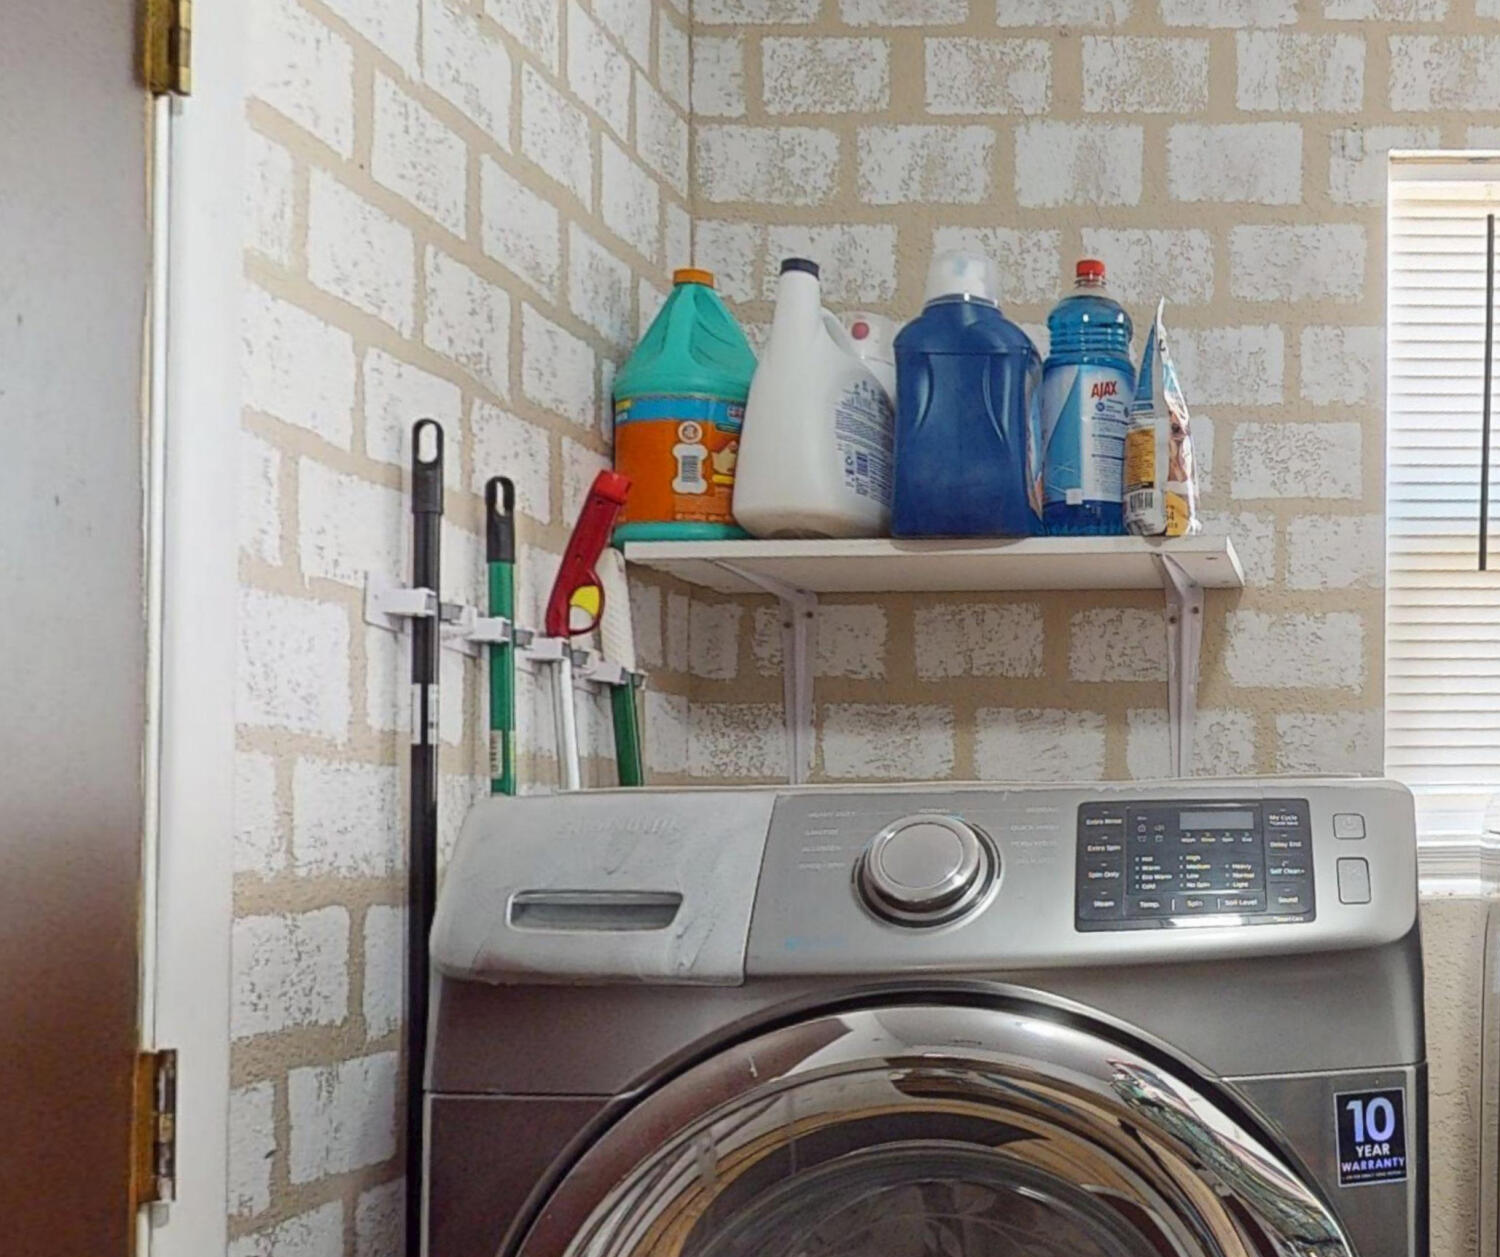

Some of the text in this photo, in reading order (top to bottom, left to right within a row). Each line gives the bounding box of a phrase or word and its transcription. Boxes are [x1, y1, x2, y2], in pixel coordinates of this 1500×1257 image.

[1091, 381, 1117, 399] AJAX
[1346, 1097, 1395, 1143] 10
[1355, 1143, 1390, 1158] YEAR
[1341, 1157, 1405, 1172] WARRANTY
